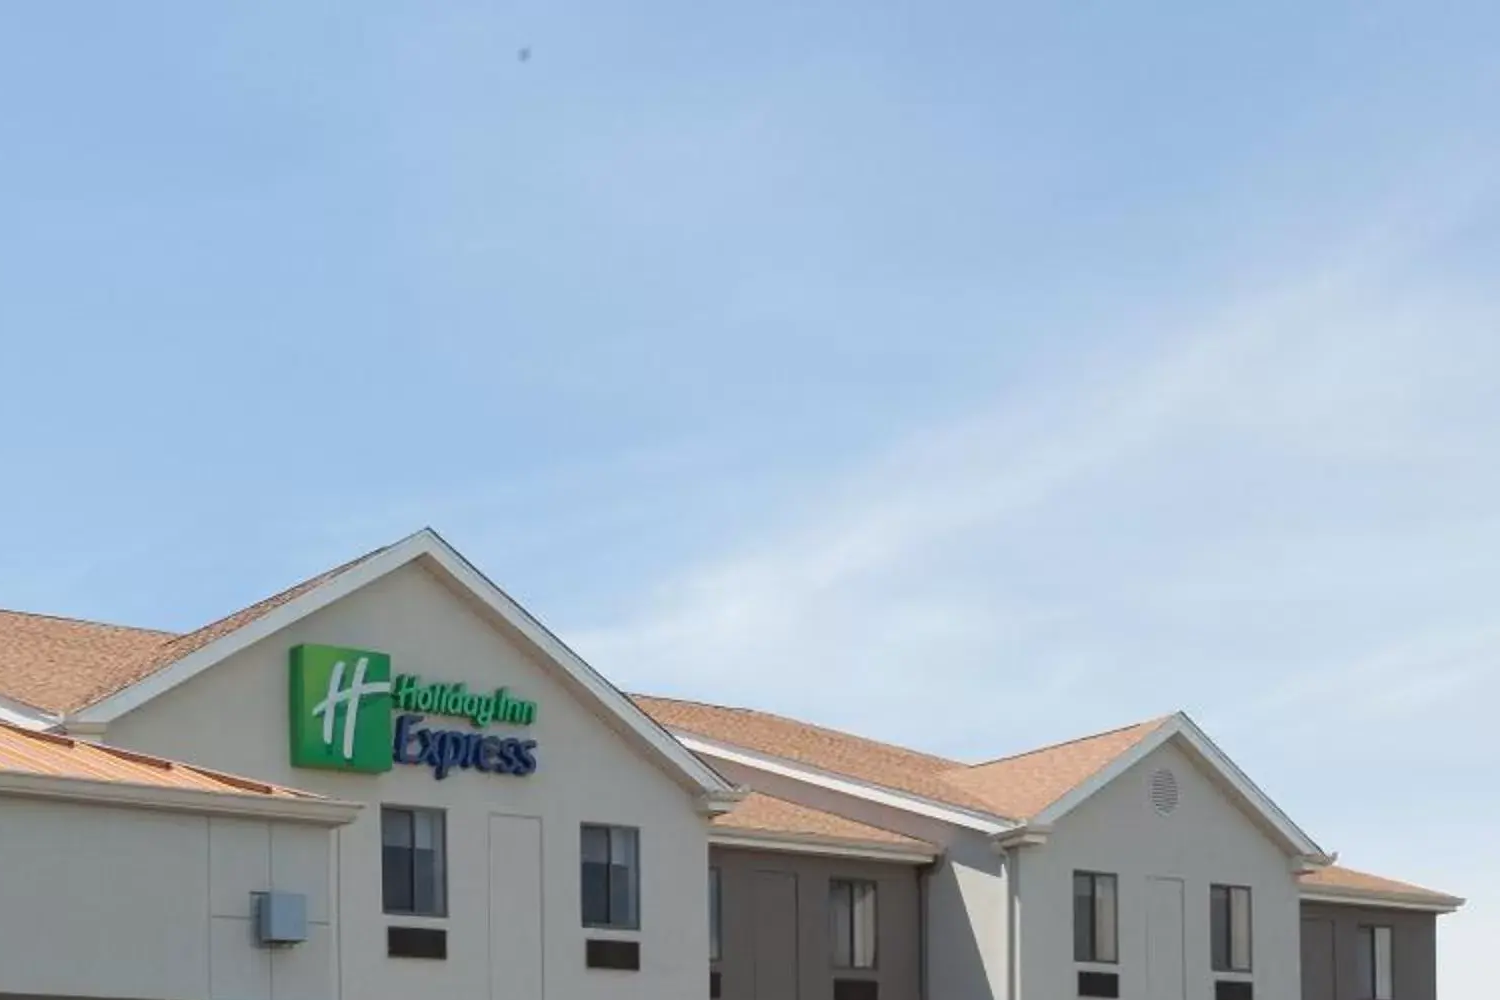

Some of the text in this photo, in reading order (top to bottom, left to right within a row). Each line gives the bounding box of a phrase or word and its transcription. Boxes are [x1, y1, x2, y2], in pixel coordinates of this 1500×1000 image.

[392, 673, 538, 728] Holiday Inn
[393, 714, 538, 780] Express
